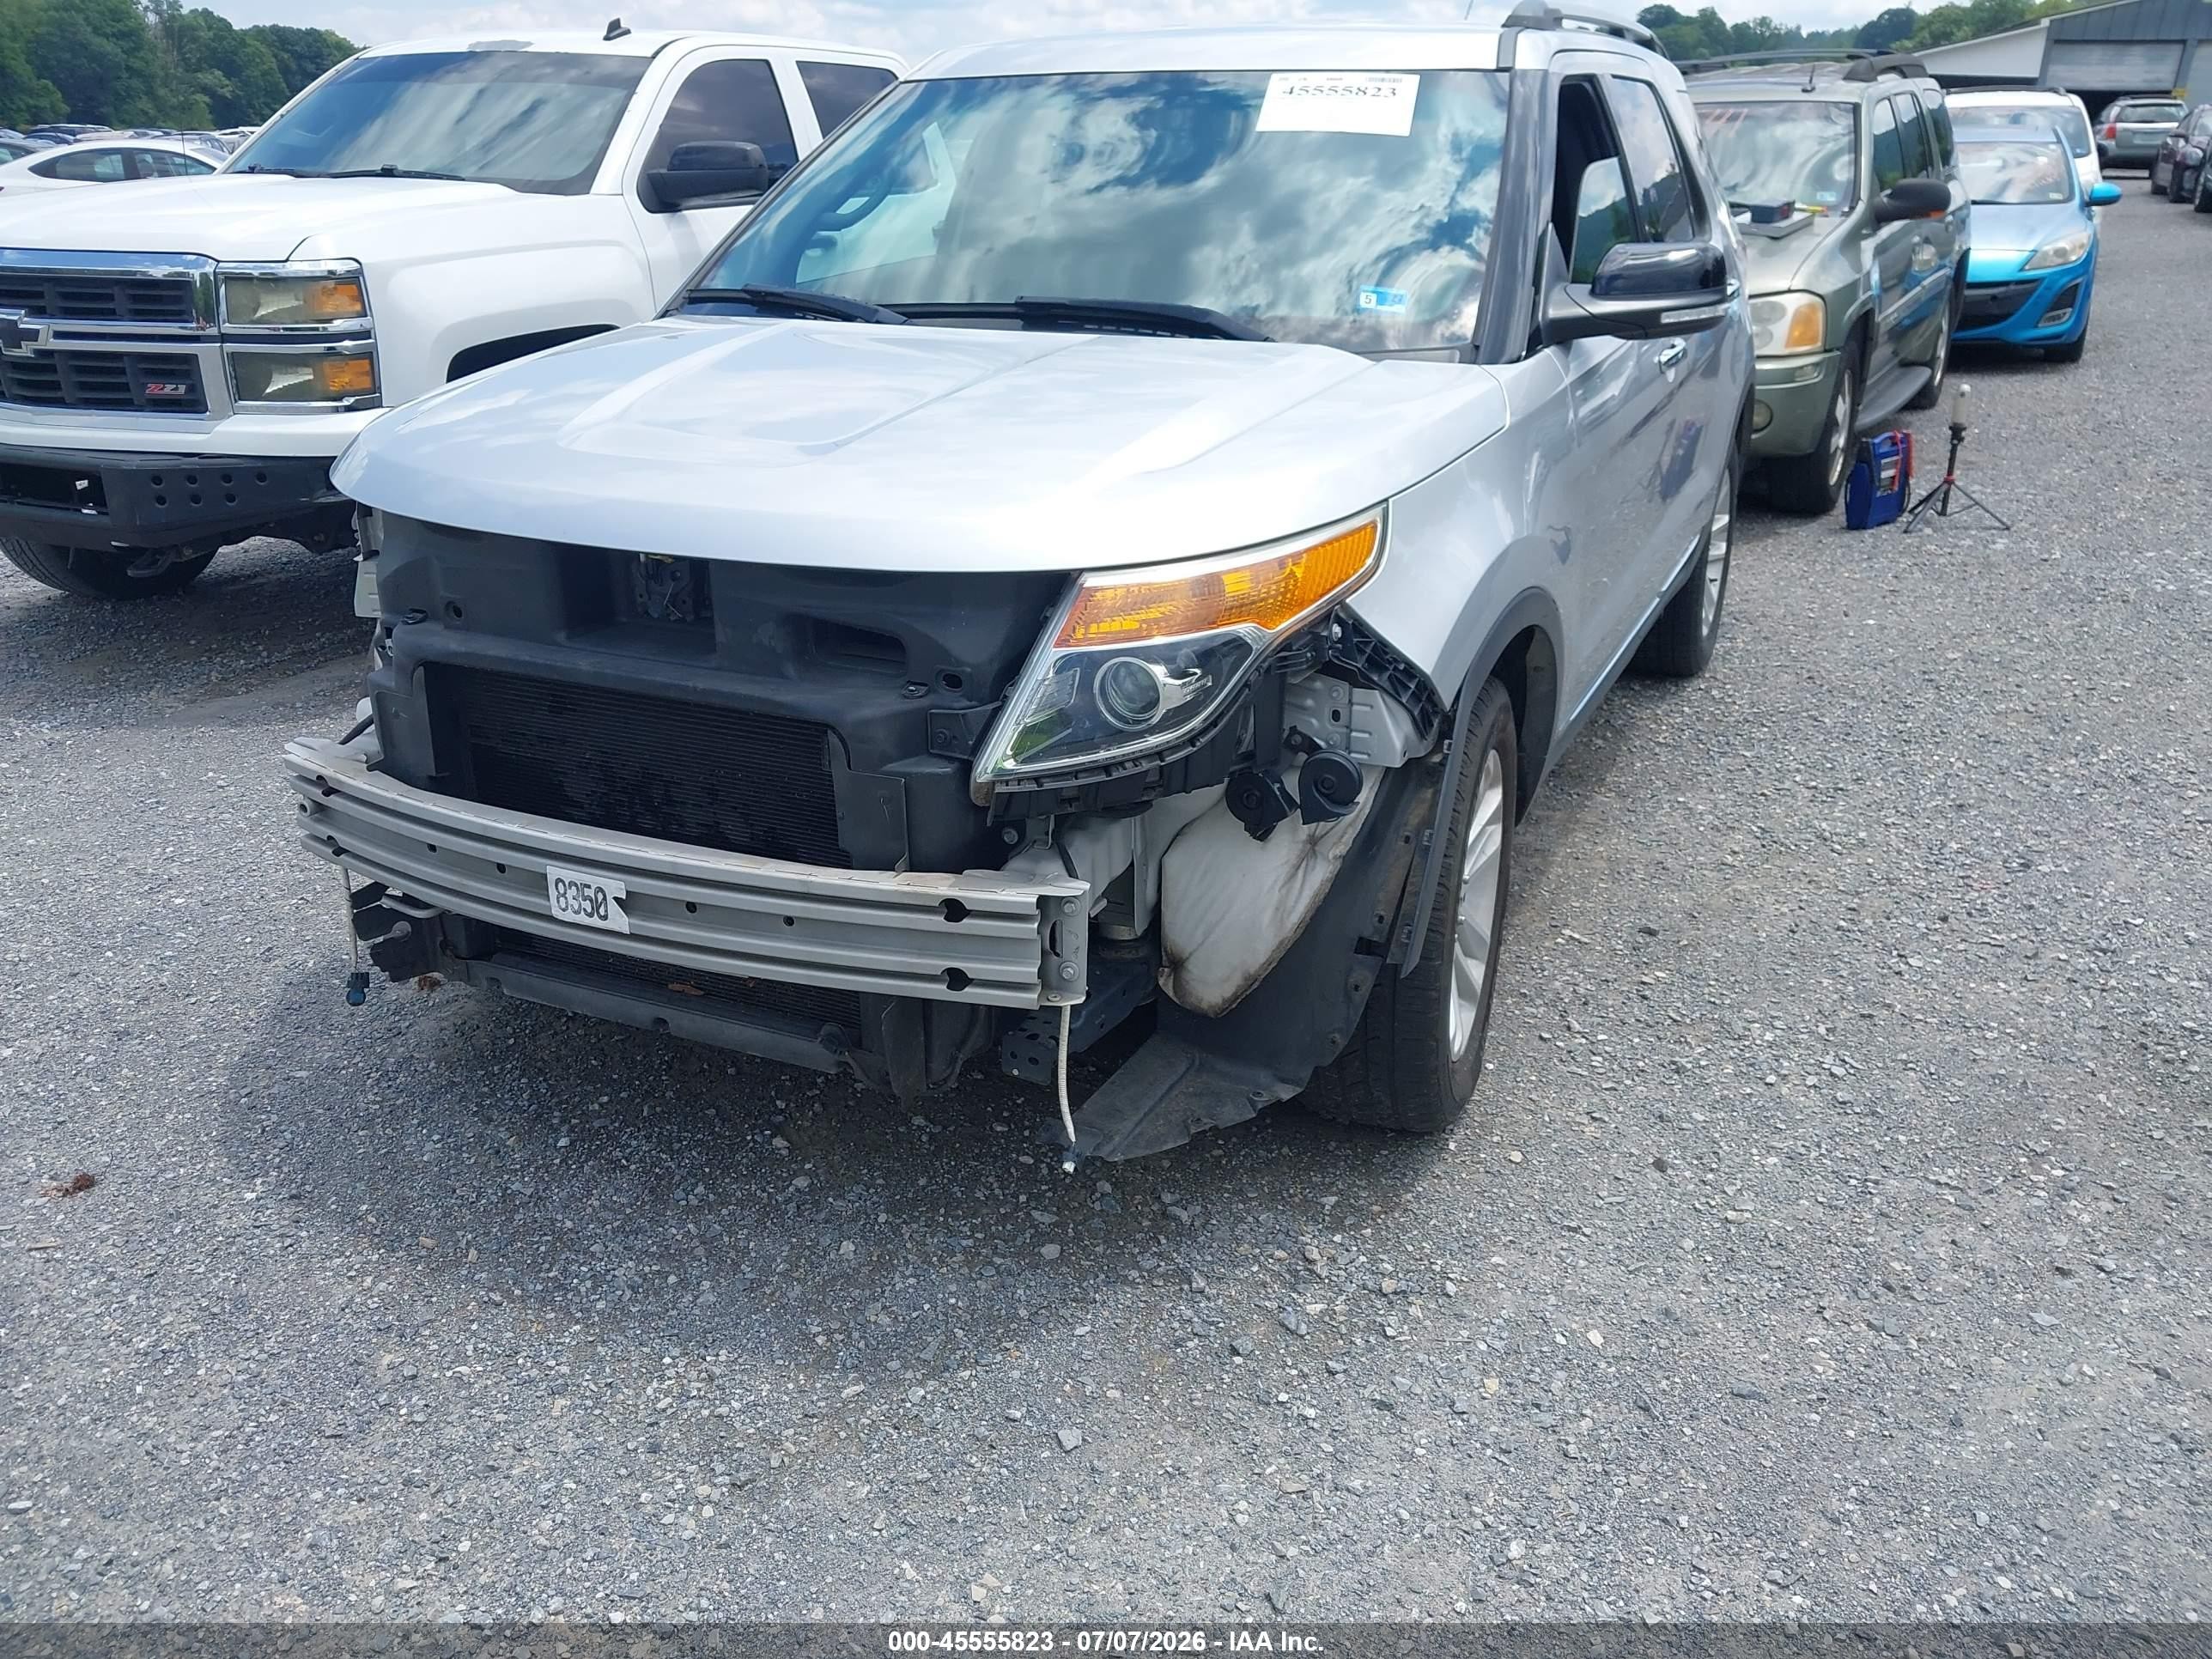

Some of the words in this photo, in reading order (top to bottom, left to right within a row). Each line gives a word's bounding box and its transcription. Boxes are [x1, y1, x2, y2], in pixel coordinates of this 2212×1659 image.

[1282, 85, 1397, 98] 45555823
[1364, 295, 1372, 305] 5
[554, 877, 610, 922] 8350
